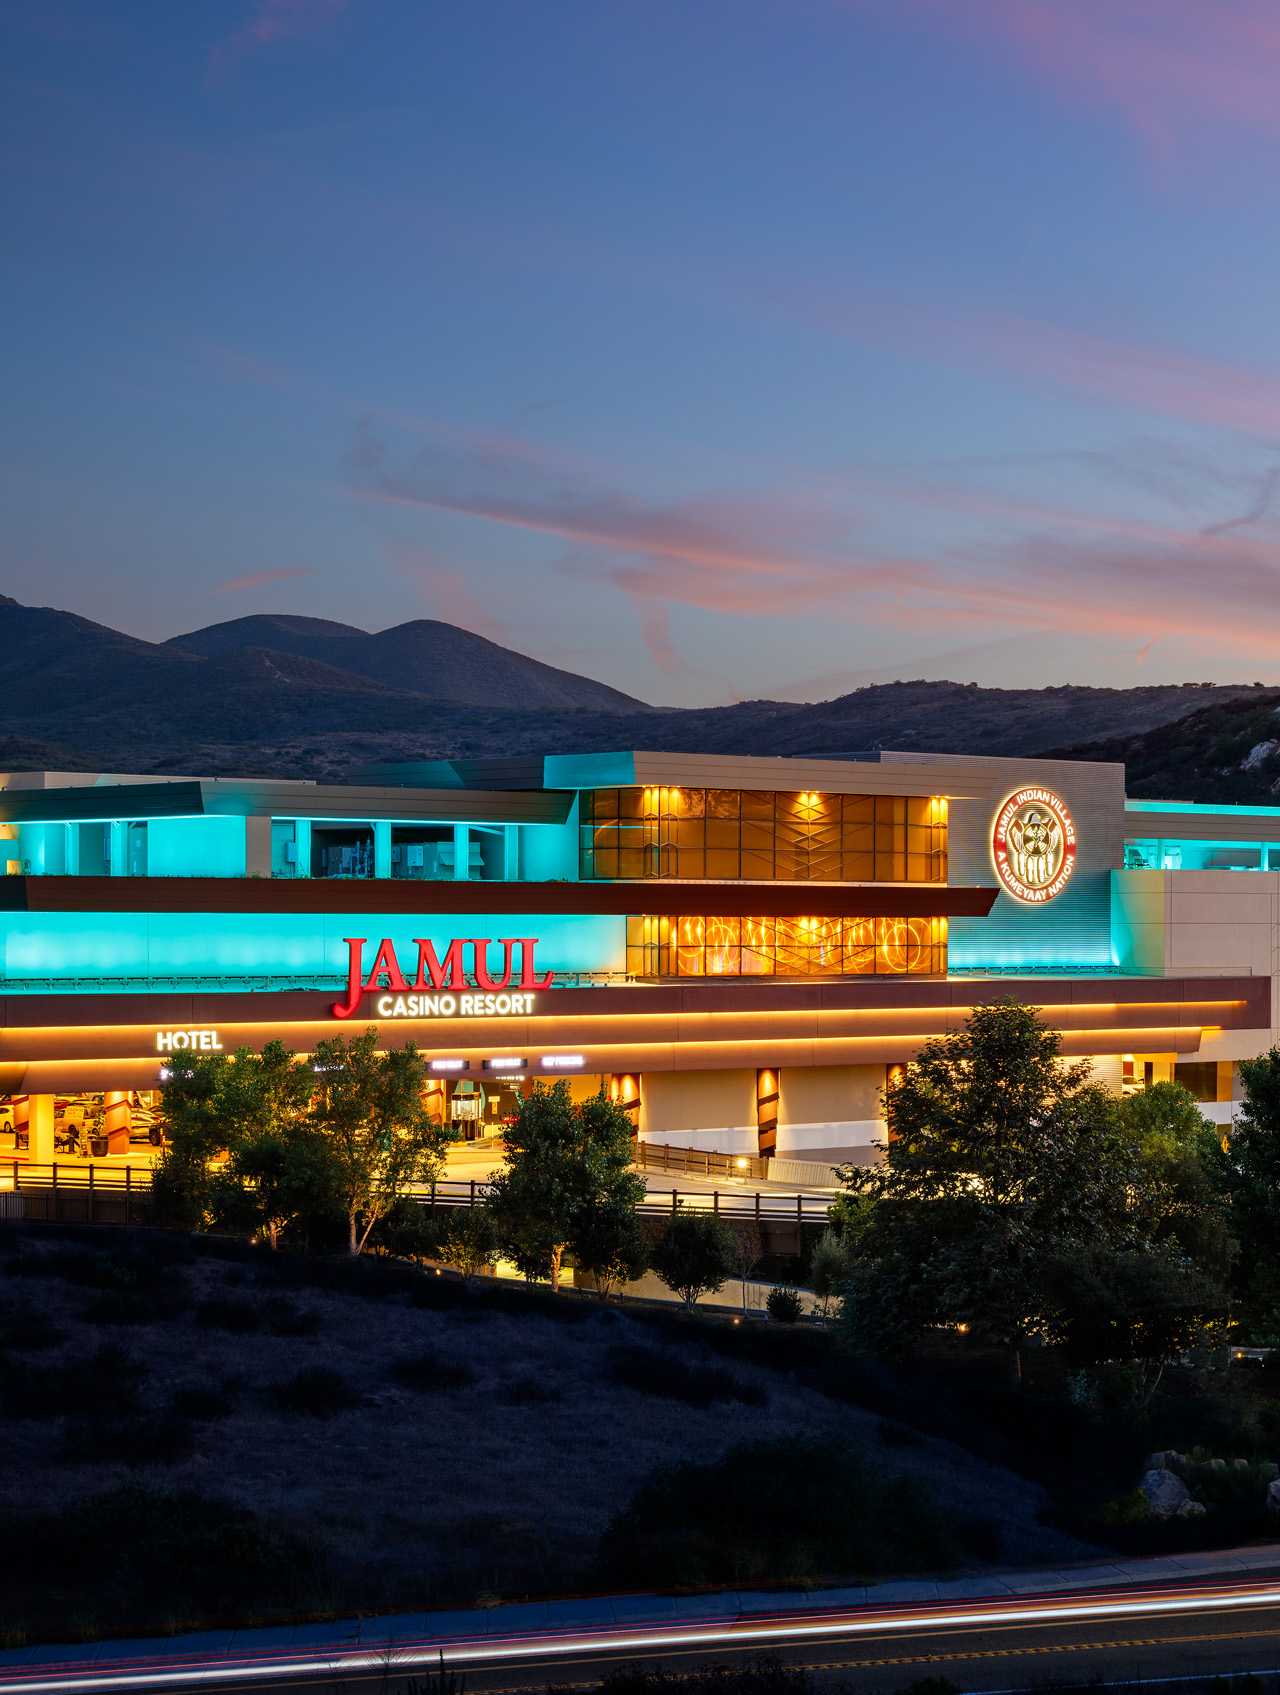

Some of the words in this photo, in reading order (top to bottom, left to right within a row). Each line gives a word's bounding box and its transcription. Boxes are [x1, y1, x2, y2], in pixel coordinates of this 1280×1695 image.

[997, 800, 1018, 842] JAMUL
[1017, 789, 1051, 807] INDIAN
[1050, 796, 1076, 845] VILLAGE
[998, 852, 1006, 861] A
[1048, 856, 1075, 897] NATION
[1000, 862, 1047, 902] KUMEYAAY
[331, 938, 554, 1019] JAMUL
[378, 995, 456, 1017] CASINO
[460, 993, 535, 1014] RESORT
[156, 1030, 223, 1051] HOTEL
